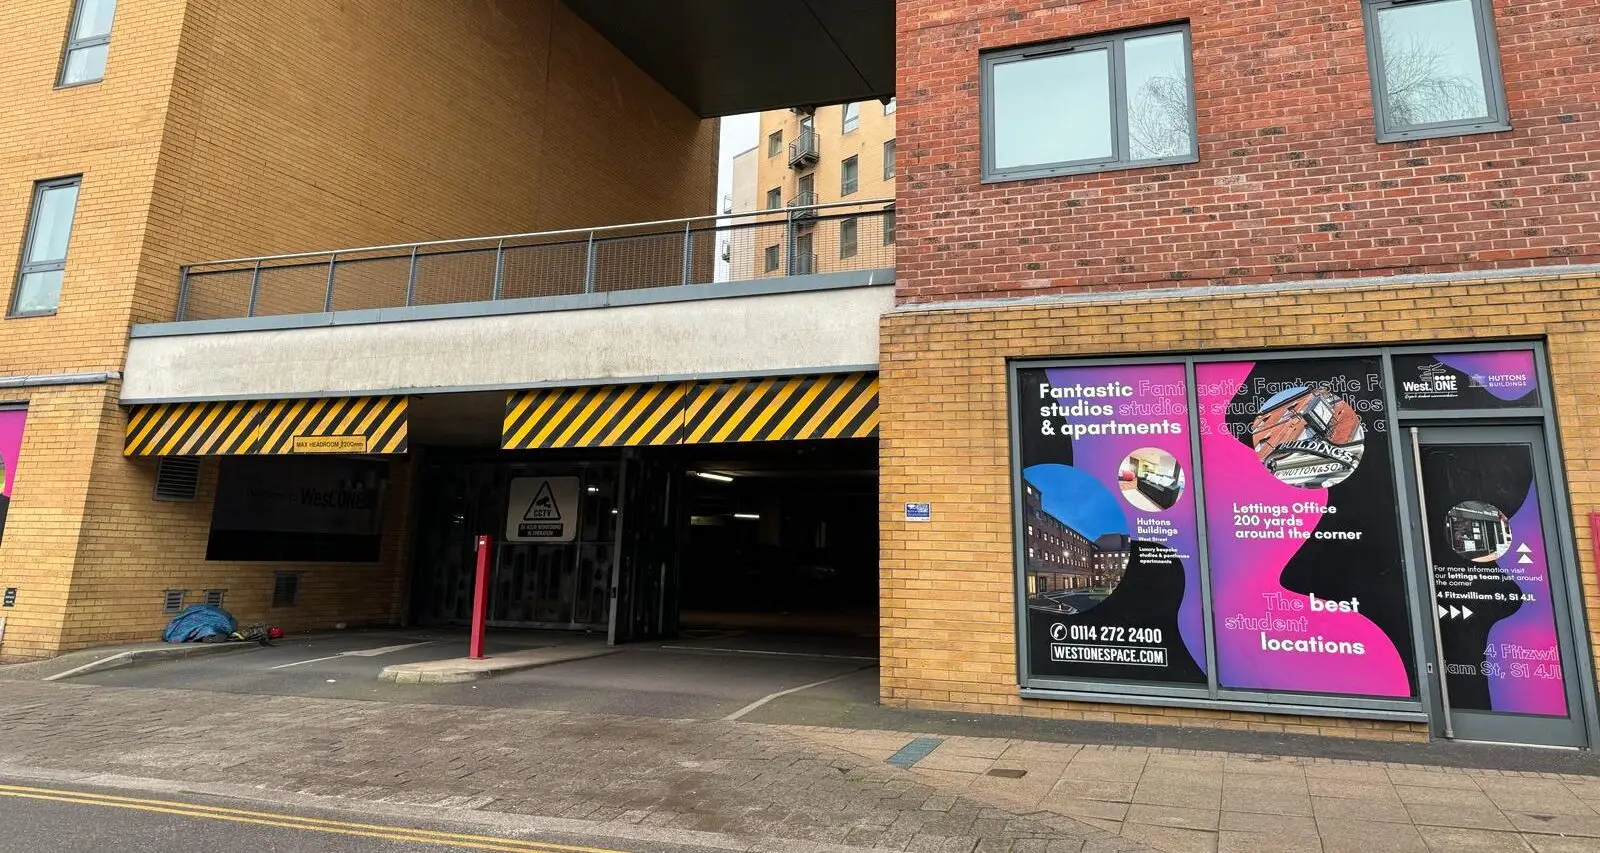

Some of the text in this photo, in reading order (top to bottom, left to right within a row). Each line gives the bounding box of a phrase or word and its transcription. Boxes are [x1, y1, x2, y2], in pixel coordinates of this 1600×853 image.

[1040, 382, 1133, 398] Fantastic
[1435, 380, 1458, 391] ONE
[1040, 400, 1114, 417] studios
[1041, 420, 1055, 436] &
[1060, 420, 1182, 440] apartments
[534, 509, 552, 518] CCTV
[1233, 502, 1337, 516] Lettings Office
[1136, 518, 1171, 526] Huttons
[1234, 515, 1304, 529] 200 yards
[1138, 526, 1178, 536] Buildings
[1235, 528, 1362, 540] around the corner
[1448, 572, 1478, 581] lettings
[1262, 592, 1360, 613] The best
[1444, 592, 1493, 600] Fitzwilliam
[1494, 592, 1508, 601] St,
[1509, 593, 1519, 601] S1
[1520, 594, 1536, 602] 4JL
[1224, 612, 1309, 632] student
[1070, 625, 1162, 644] 0114 272 2400
[1260, 632, 1366, 656] locations
[1483, 644, 1497, 658] 4
[1054, 646, 1164, 664] WESTONESPACE.COM
[1480, 660, 1506, 678] St,
[1510, 662, 1530, 678] S1
